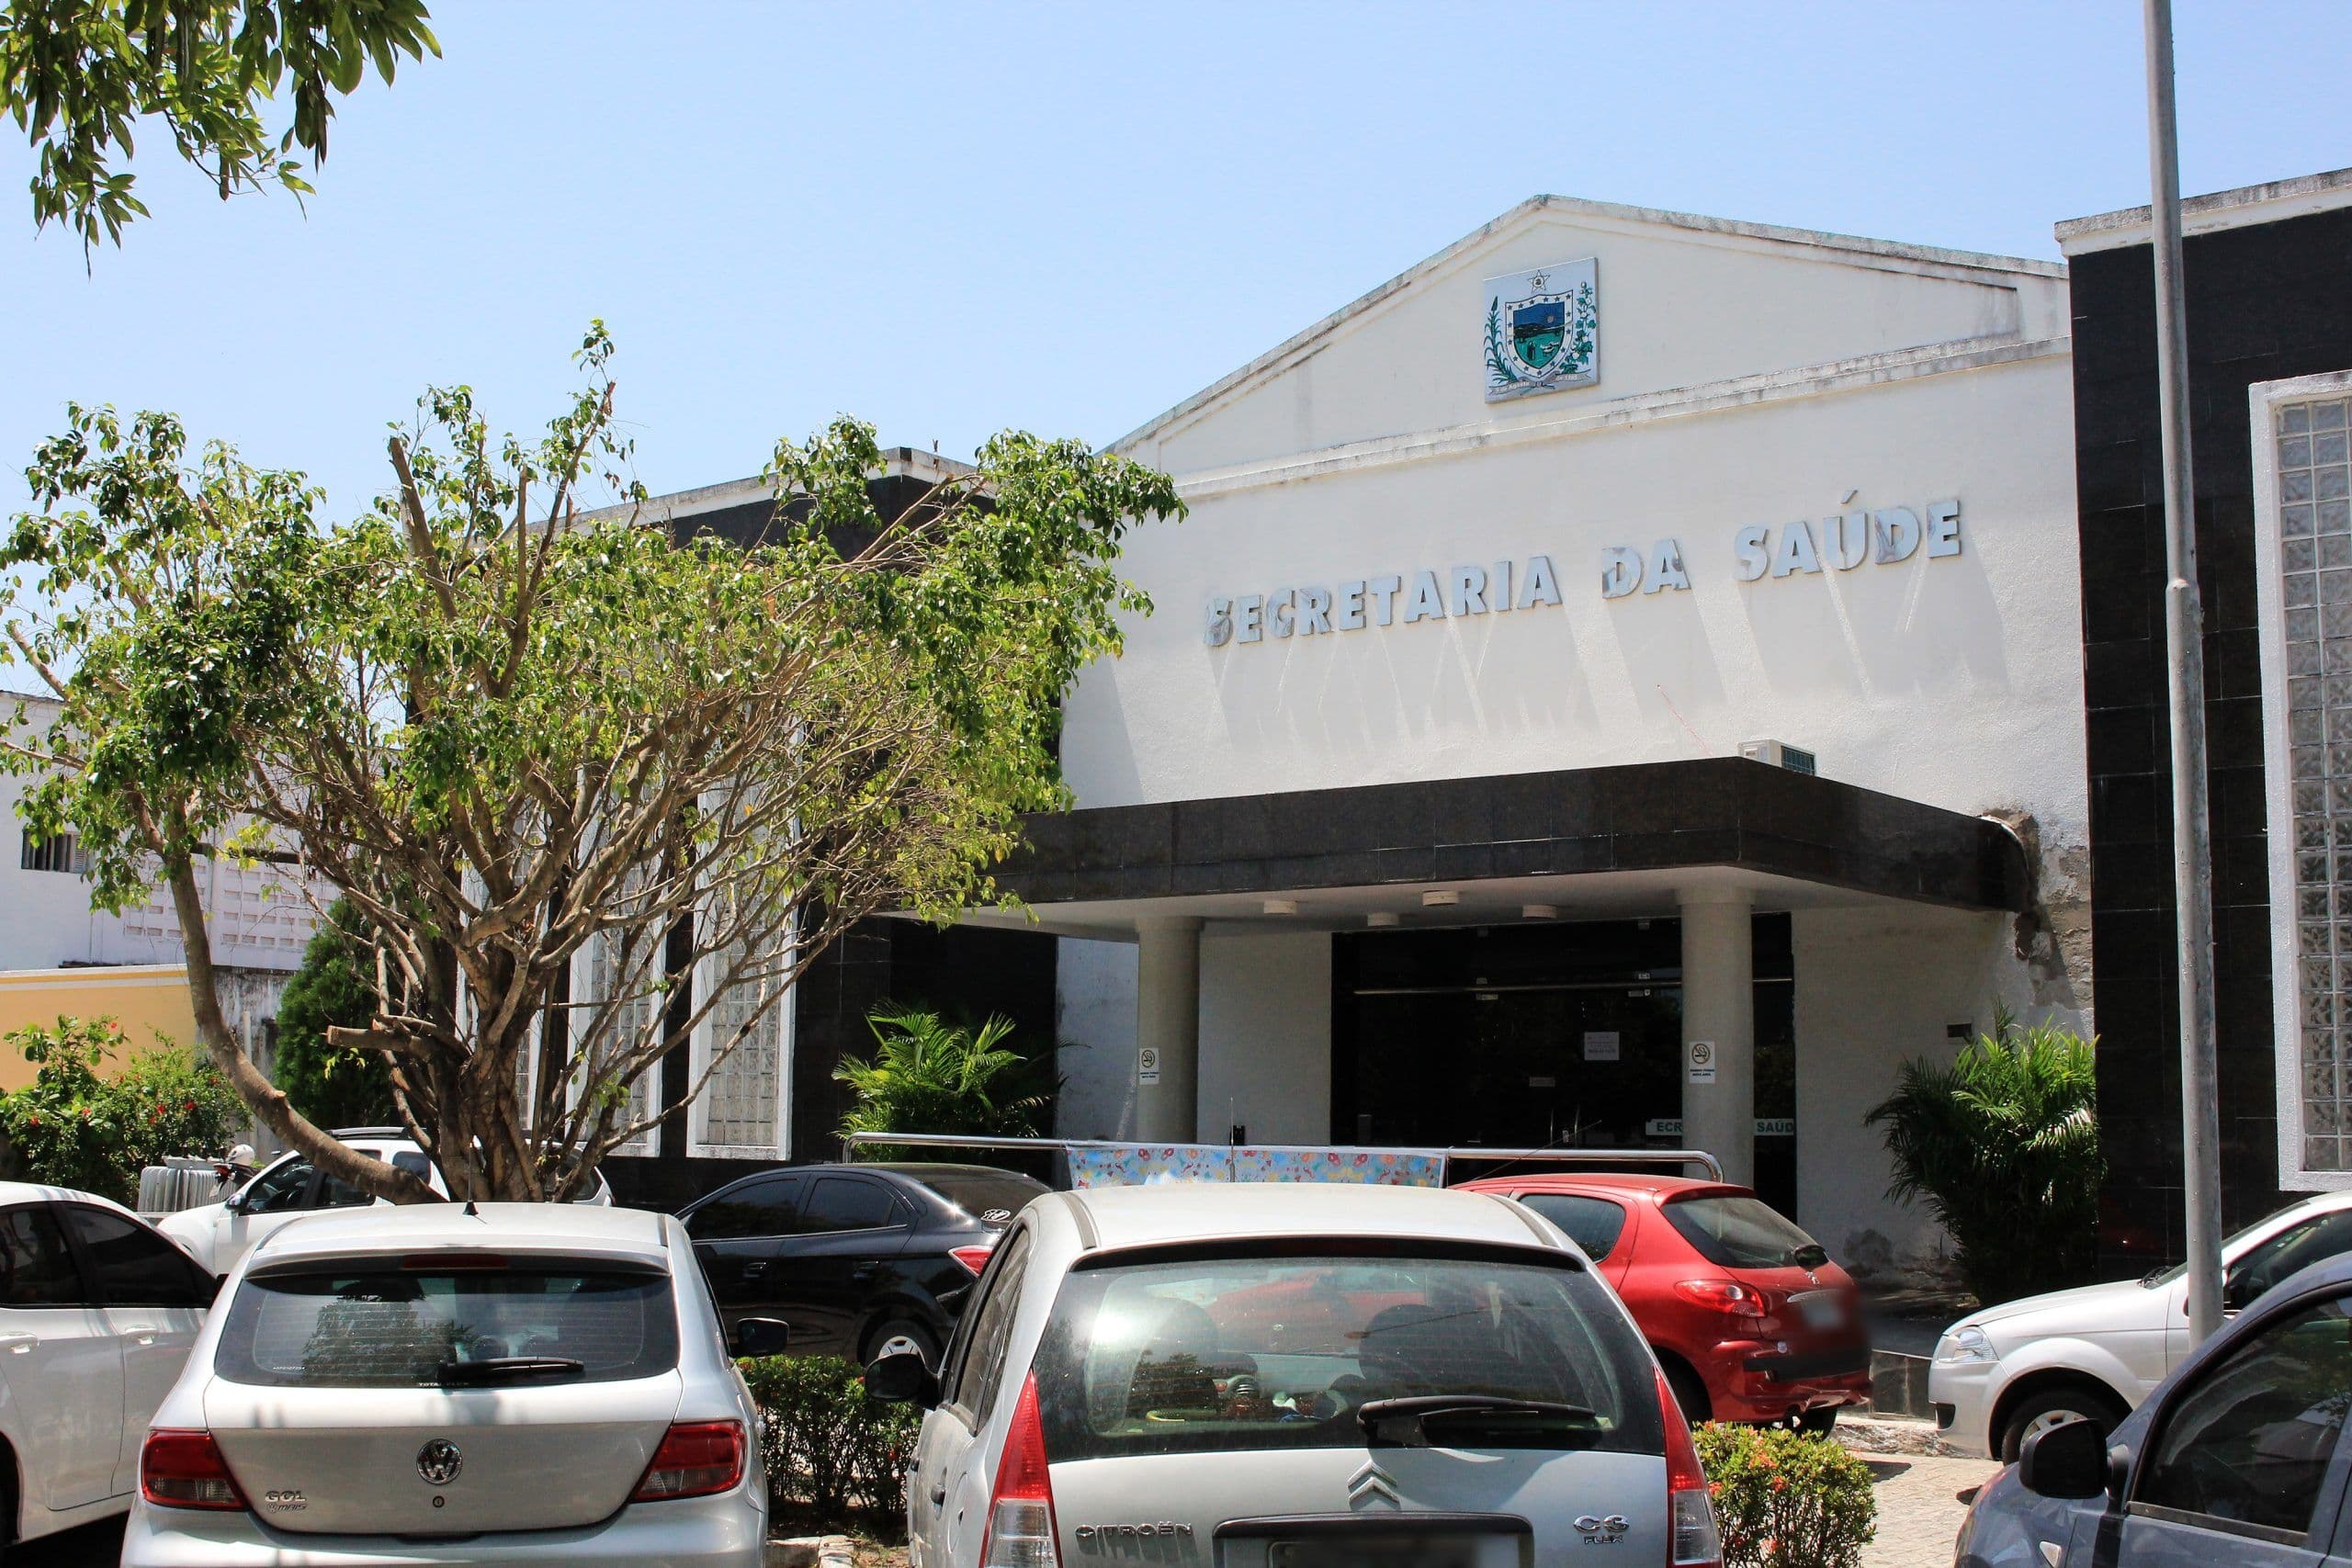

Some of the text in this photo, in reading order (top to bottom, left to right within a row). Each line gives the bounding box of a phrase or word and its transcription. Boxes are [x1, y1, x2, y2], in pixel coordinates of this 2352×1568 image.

[1204, 490, 1962, 648] SECRETARIA DA SAÚDE
[265, 1490, 307, 1502] GOL
[1074, 1521, 1193, 1537] CITROËN
[1573, 1514, 1630, 1533] C3
[1584, 1535, 1624, 1544] FLEX
